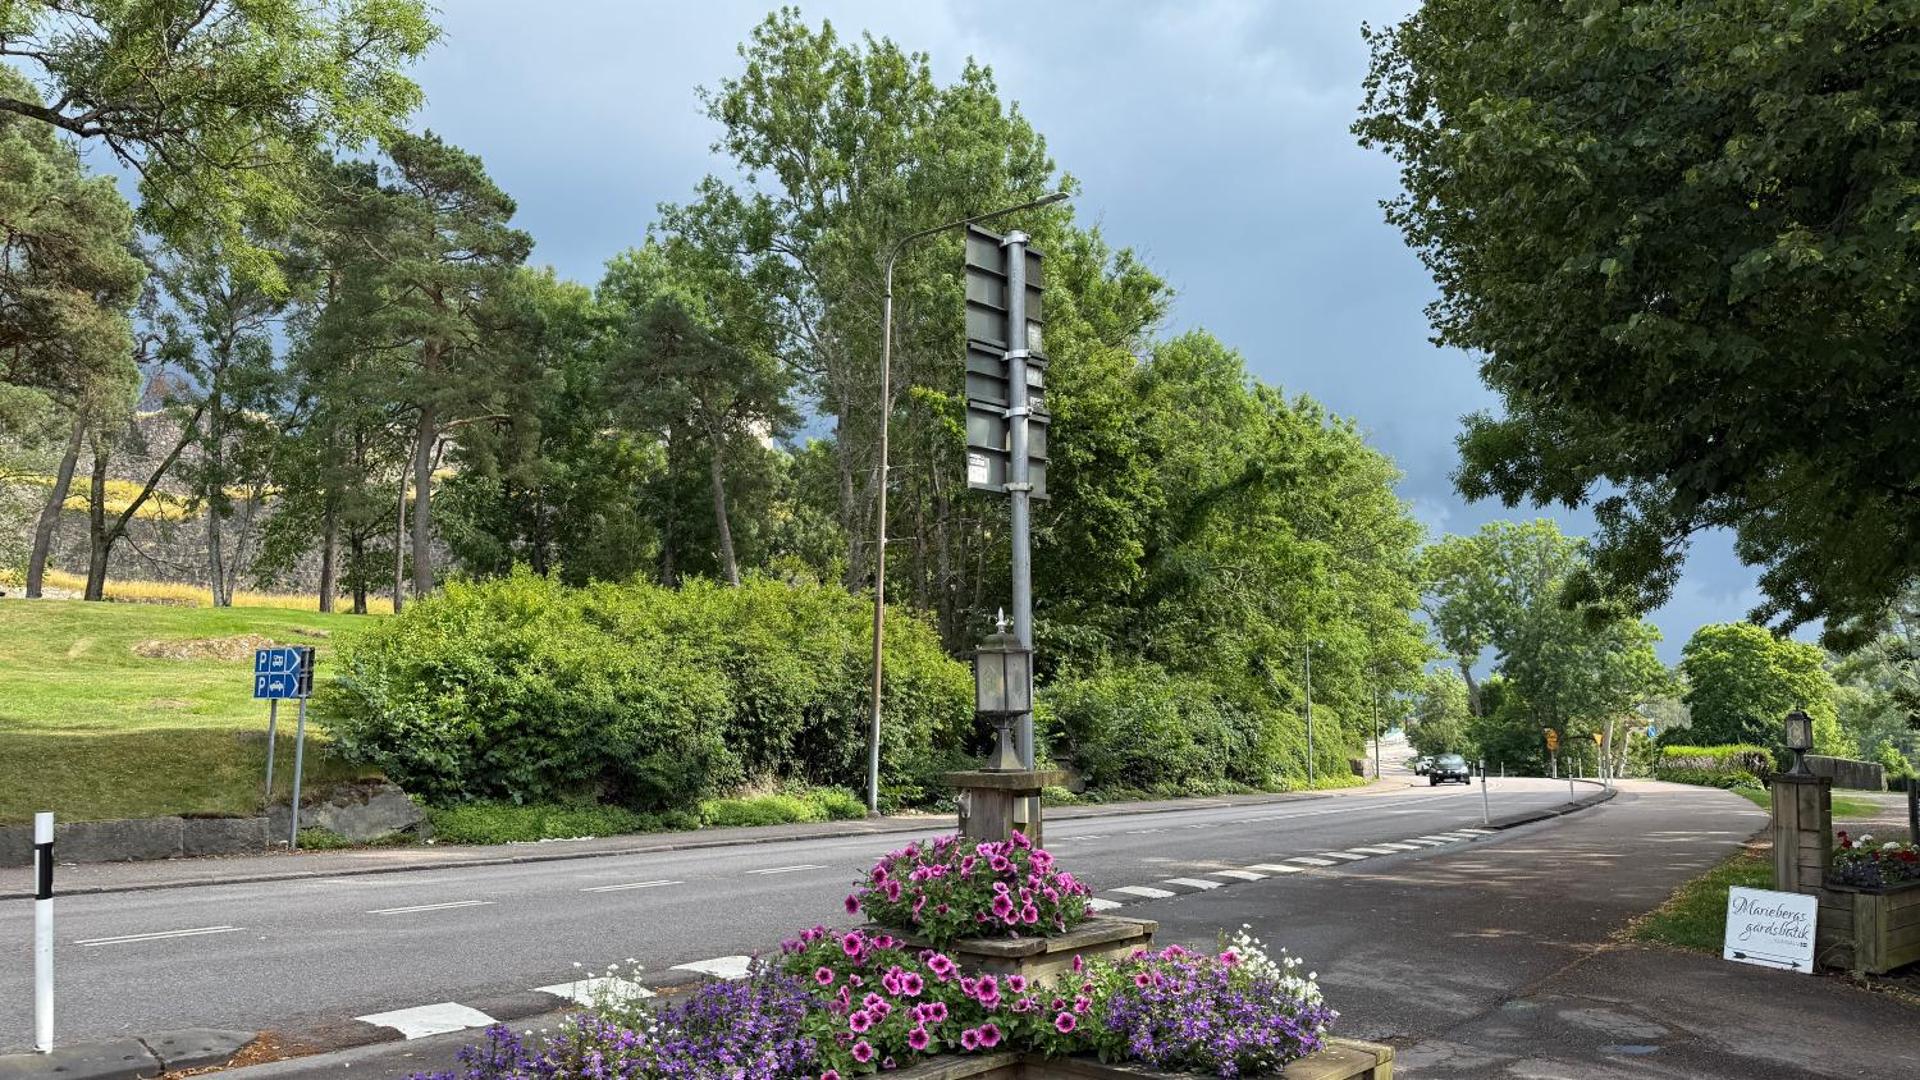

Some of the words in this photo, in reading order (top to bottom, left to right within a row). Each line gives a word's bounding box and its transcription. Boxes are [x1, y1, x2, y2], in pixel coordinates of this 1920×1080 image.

[259, 652, 267, 671] P
[258, 677, 266, 696] P
[1732, 896, 1807, 927] Mariebergs
